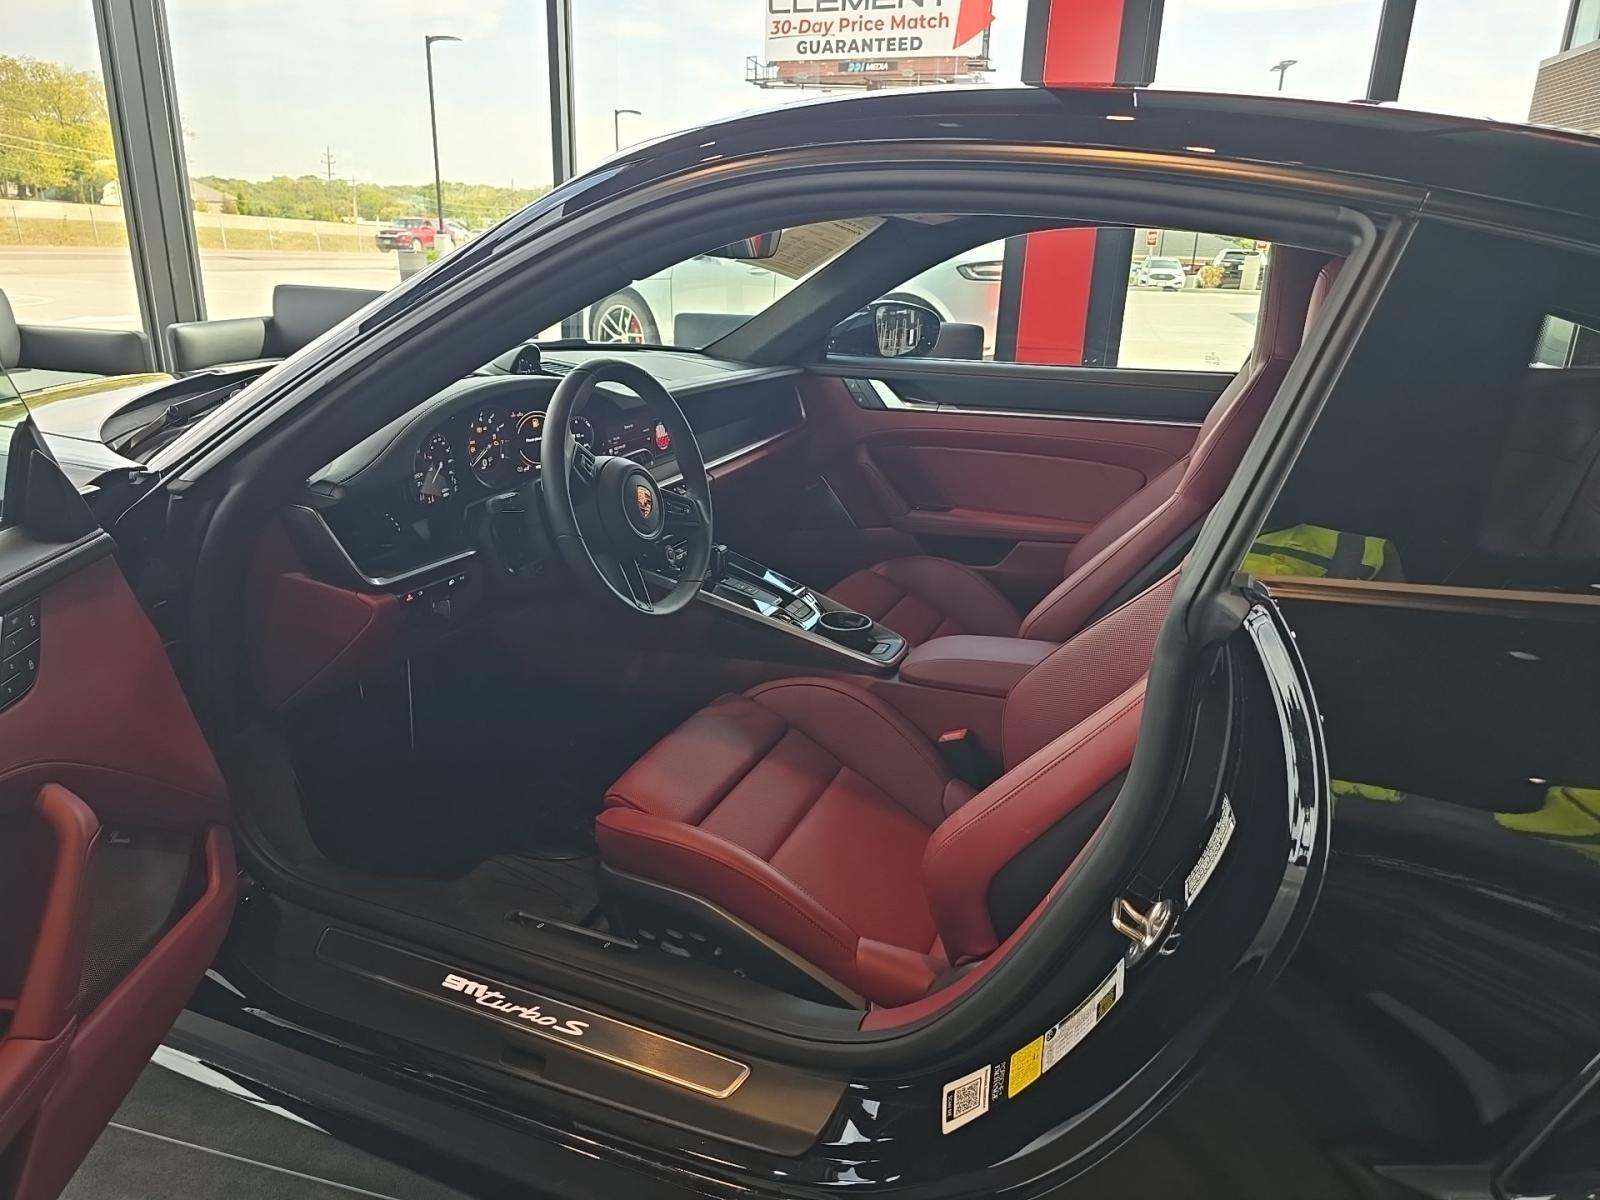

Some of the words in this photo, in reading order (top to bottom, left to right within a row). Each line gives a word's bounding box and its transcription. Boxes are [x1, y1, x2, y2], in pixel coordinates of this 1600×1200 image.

[770, 19, 834, 37] 30-Day
[839, 15, 885, 33] Price
[890, 13, 950, 32] Match
[796, 36, 923, 55] GUARANTEED
[865, 63, 889, 72] MEDIA
[552, 1020, 590, 1036] S
